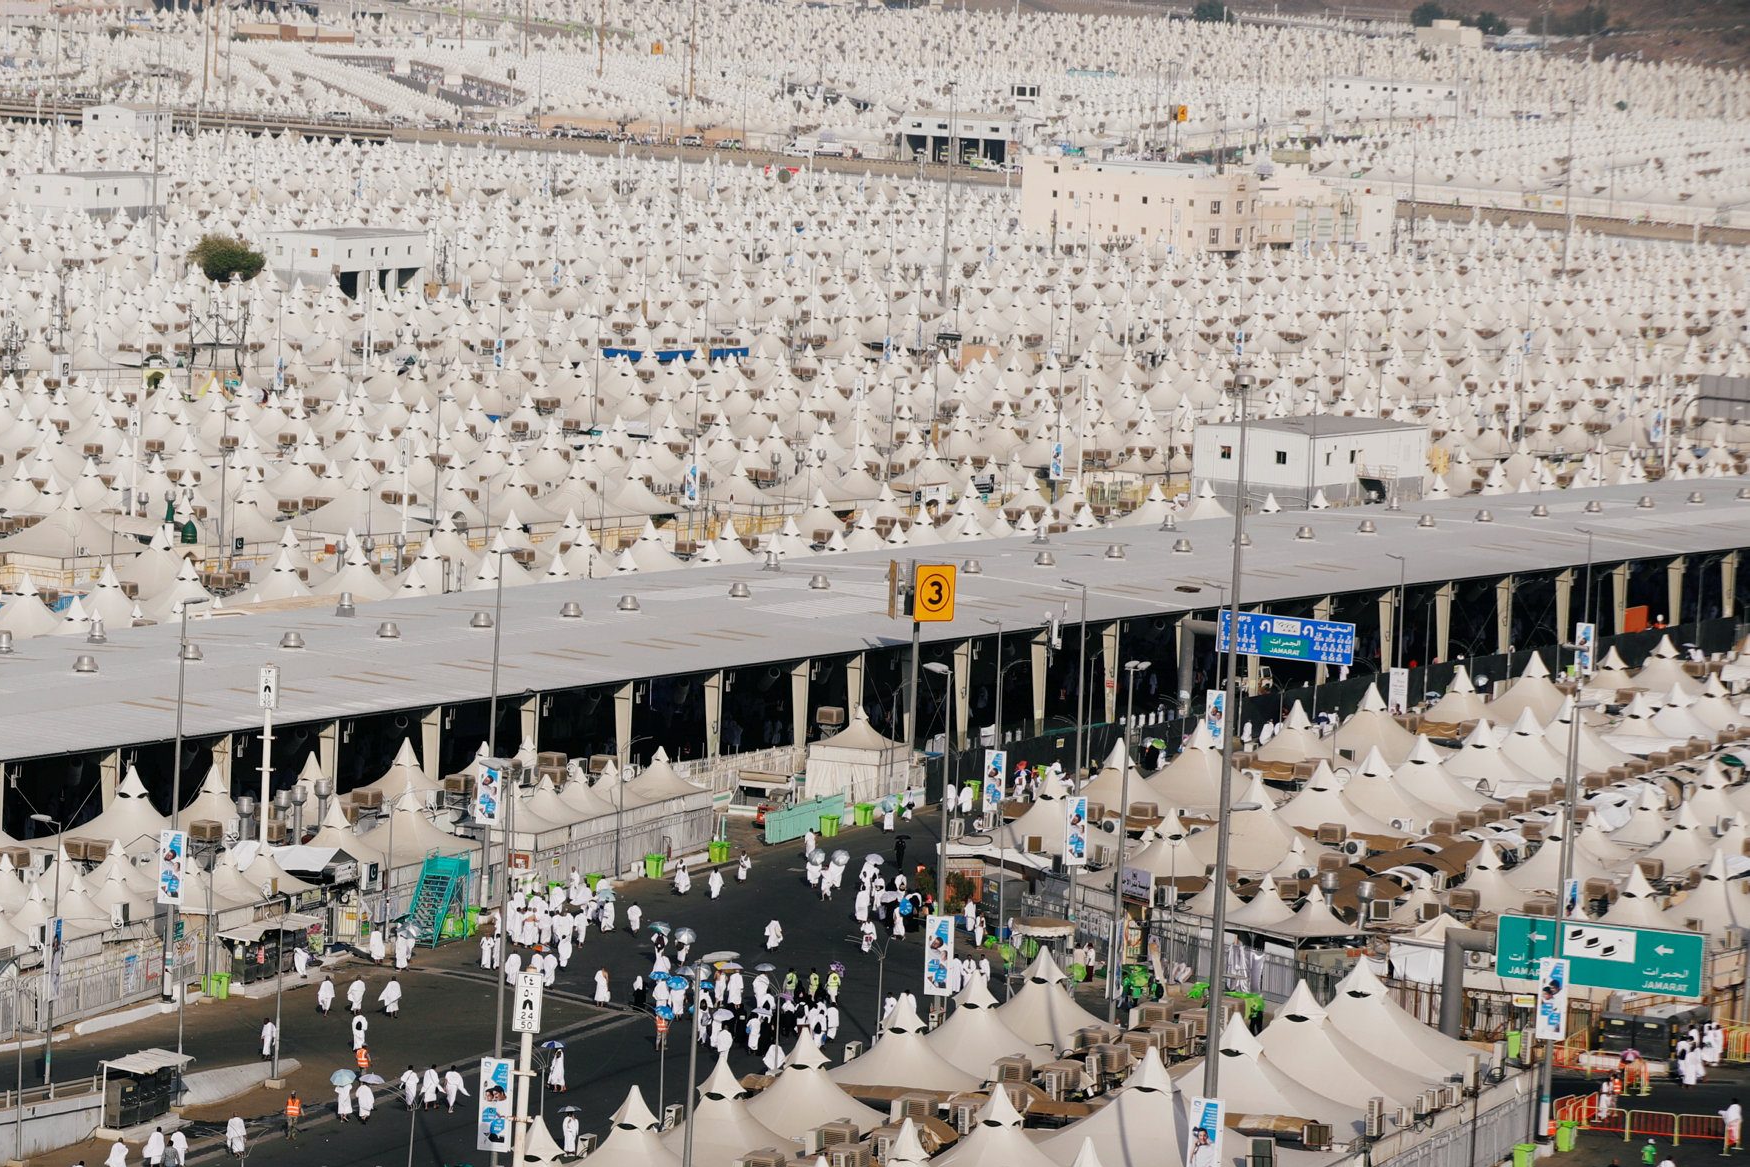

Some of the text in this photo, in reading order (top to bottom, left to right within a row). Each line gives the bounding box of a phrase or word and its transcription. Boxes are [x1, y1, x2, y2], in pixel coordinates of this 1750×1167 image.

[928, 581, 942, 605] 3
[1226, 614, 1252, 622] CMPS
[1270, 647, 1300, 656] JAMARAT
[1642, 967, 1689, 980] الجمرات
[1642, 982, 1689, 992] JAMARAT
[521, 1011, 533, 1020] 24
[521, 1021, 532, 1030] 50
